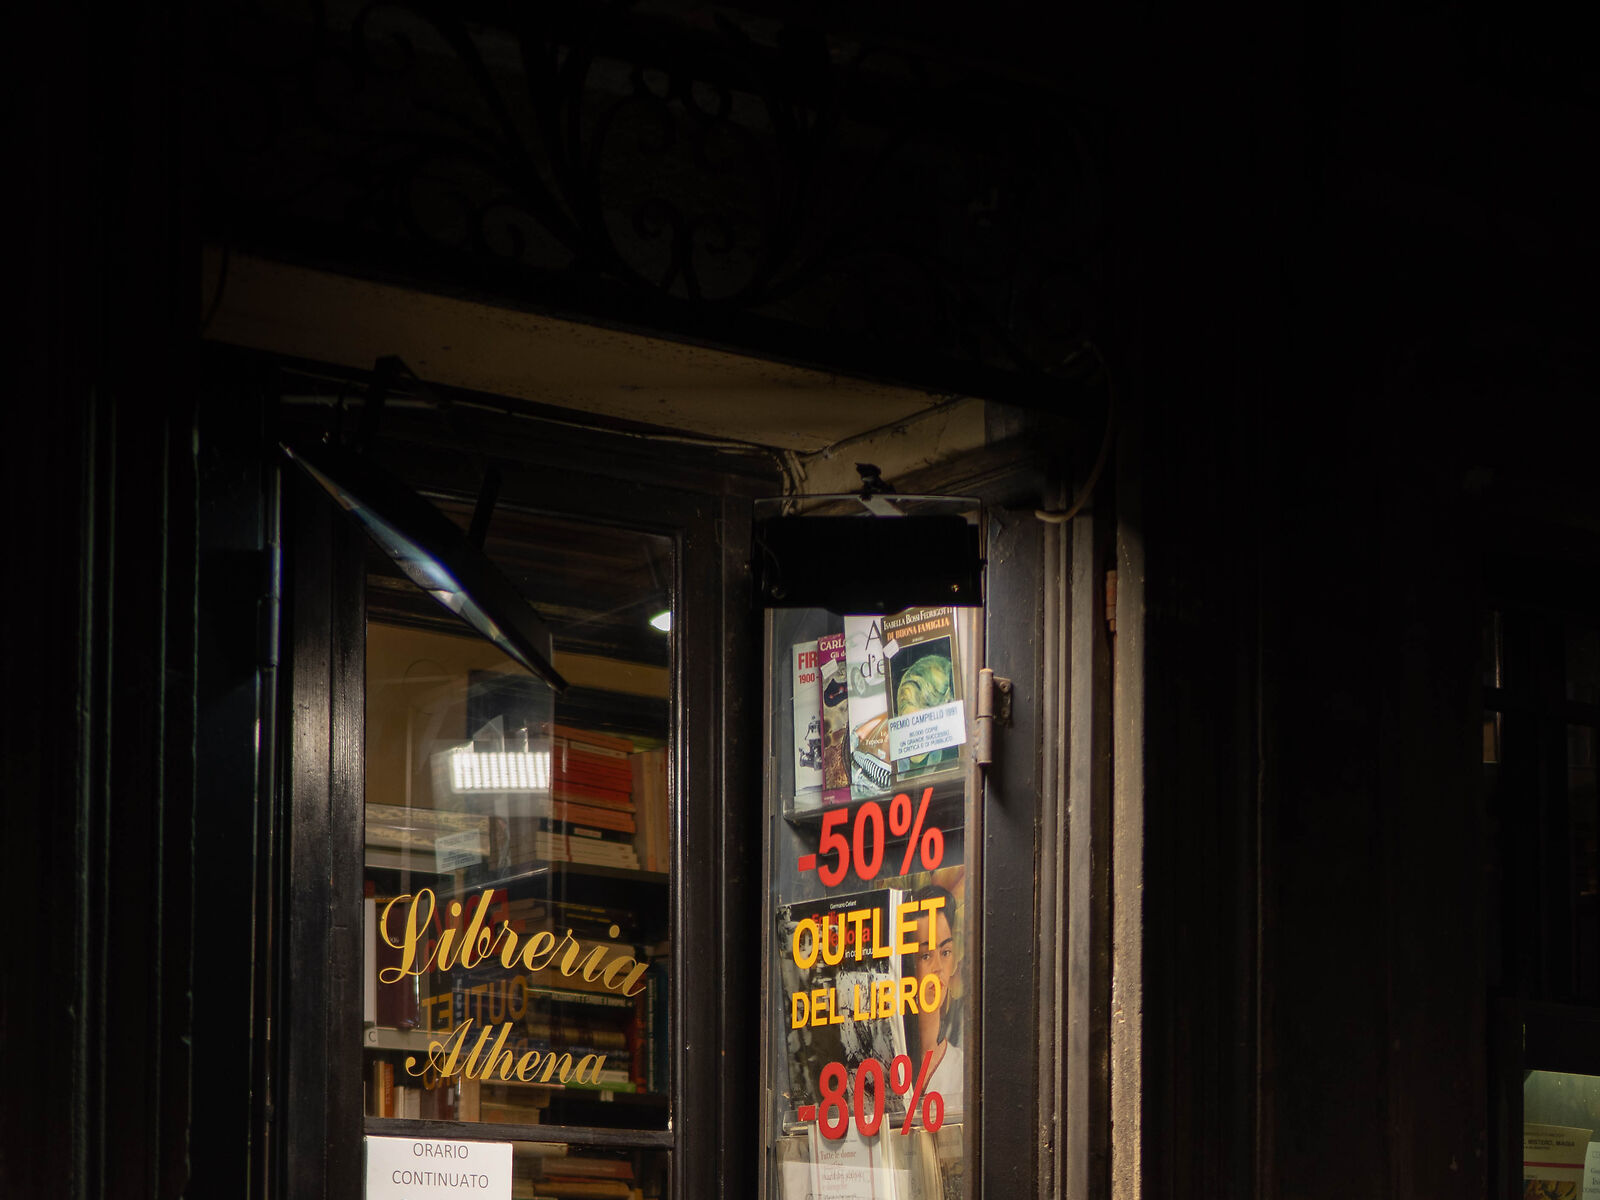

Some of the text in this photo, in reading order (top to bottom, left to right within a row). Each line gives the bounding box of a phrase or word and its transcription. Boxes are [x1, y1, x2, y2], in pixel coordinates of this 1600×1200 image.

[917, 617, 950, 633] FAMIGLIA
[889, 718, 910, 731] PREMIO
[912, 709, 944, 726] CAMPIELLO
[903, 744, 920, 752] CRITICA
[798, 787, 944, 888] -50%
[379, 888, 649, 997] Libreria
[792, 896, 946, 970] OUTLET
[791, 973, 942, 1029] DEL LIBRO
[405, 1018, 607, 1085] Athena
[797, 1050, 945, 1140] -80%
[392, 1170, 489, 1188] CONTINUATO
[413, 1143, 469, 1159] ORARIO
